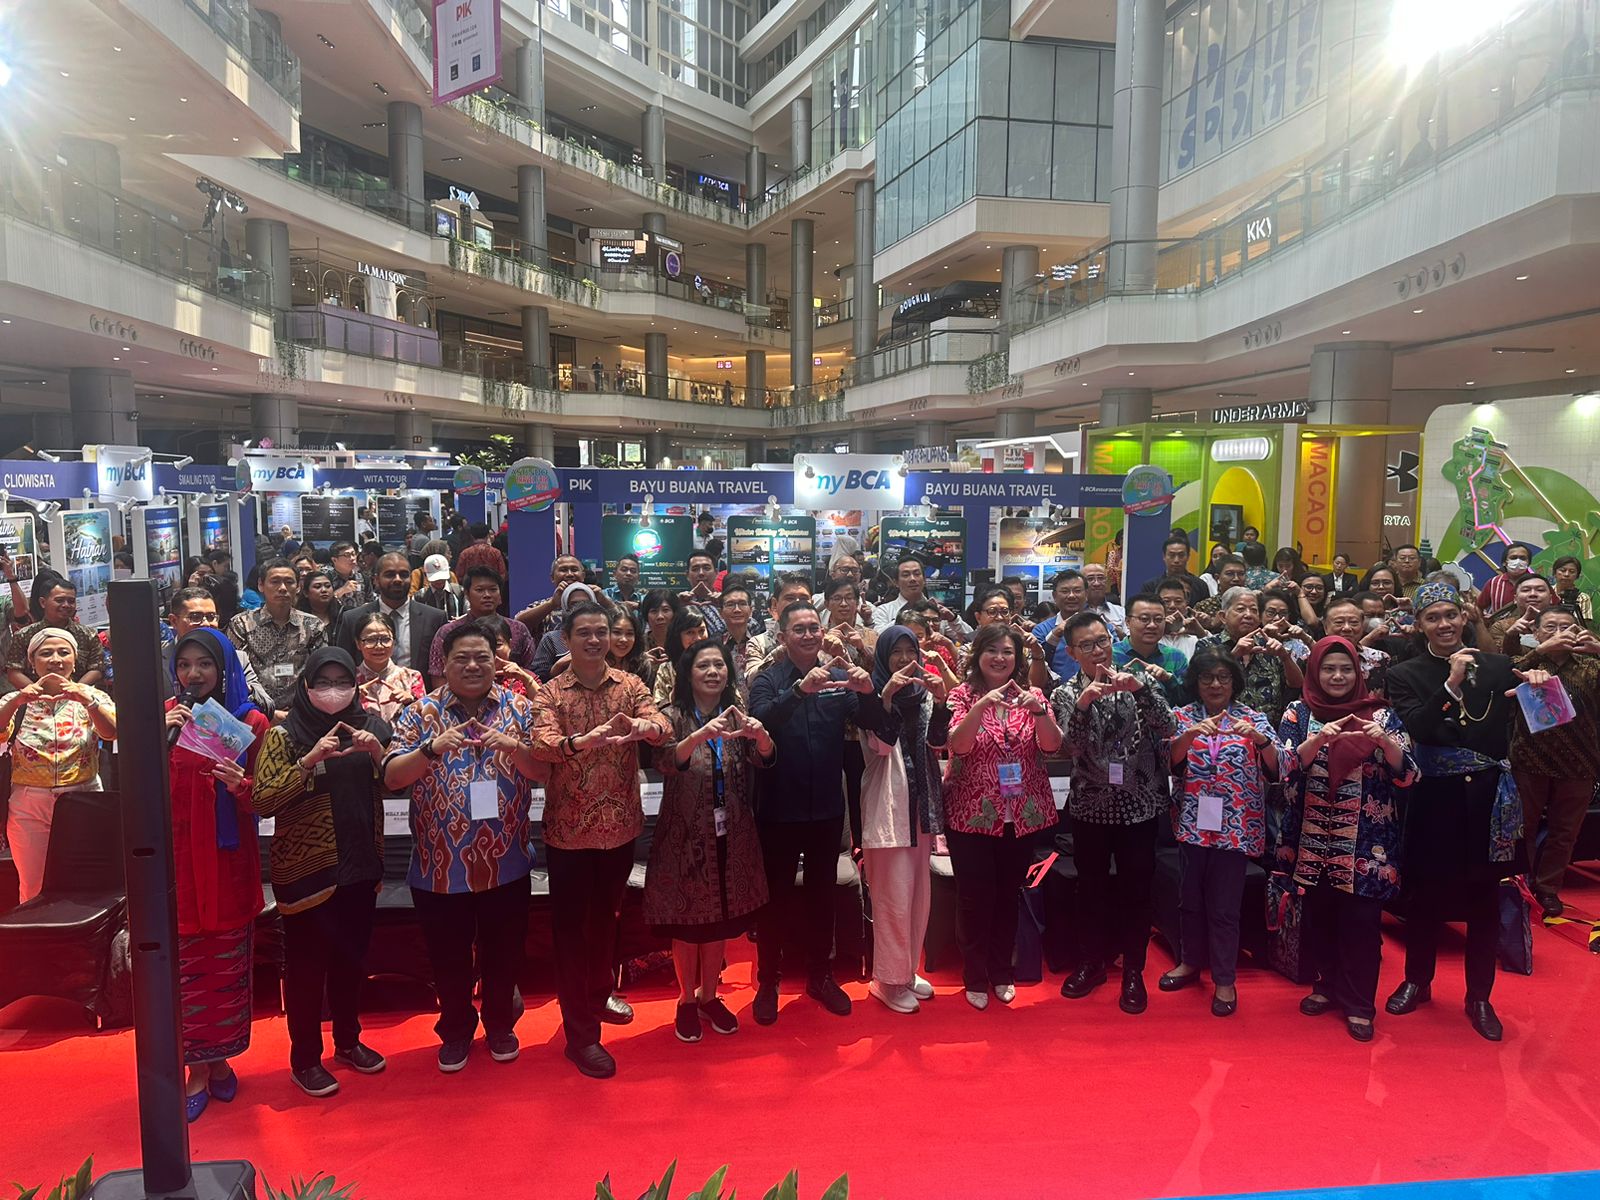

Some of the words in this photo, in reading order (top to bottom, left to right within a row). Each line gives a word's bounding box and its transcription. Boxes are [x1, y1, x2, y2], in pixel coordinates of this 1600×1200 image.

[358, 261, 370, 275] LA
[369, 266, 405, 286] MAISON
[1214, 404, 1260, 424] UNDER
[4, 473, 55, 488] CLIOWISATA
[203, 474, 216, 485] TOUR
[253, 466, 305, 482] myBCA
[363, 474, 384, 483] WITA
[386, 475, 408, 484] TOUR
[569, 479, 592, 491] PIK
[629, 480, 666, 493] BAYU
[669, 481, 715, 494] BUANA
[717, 481, 768, 494] TRAVEL
[816, 470, 891, 495] myBCA
[925, 482, 960, 496] BAYU
[962, 483, 1006, 496] BUANA
[1008, 484, 1057, 496] TRAVEL
[1306, 440, 1329, 536] MACAO
[70, 538, 108, 560] Hainan
